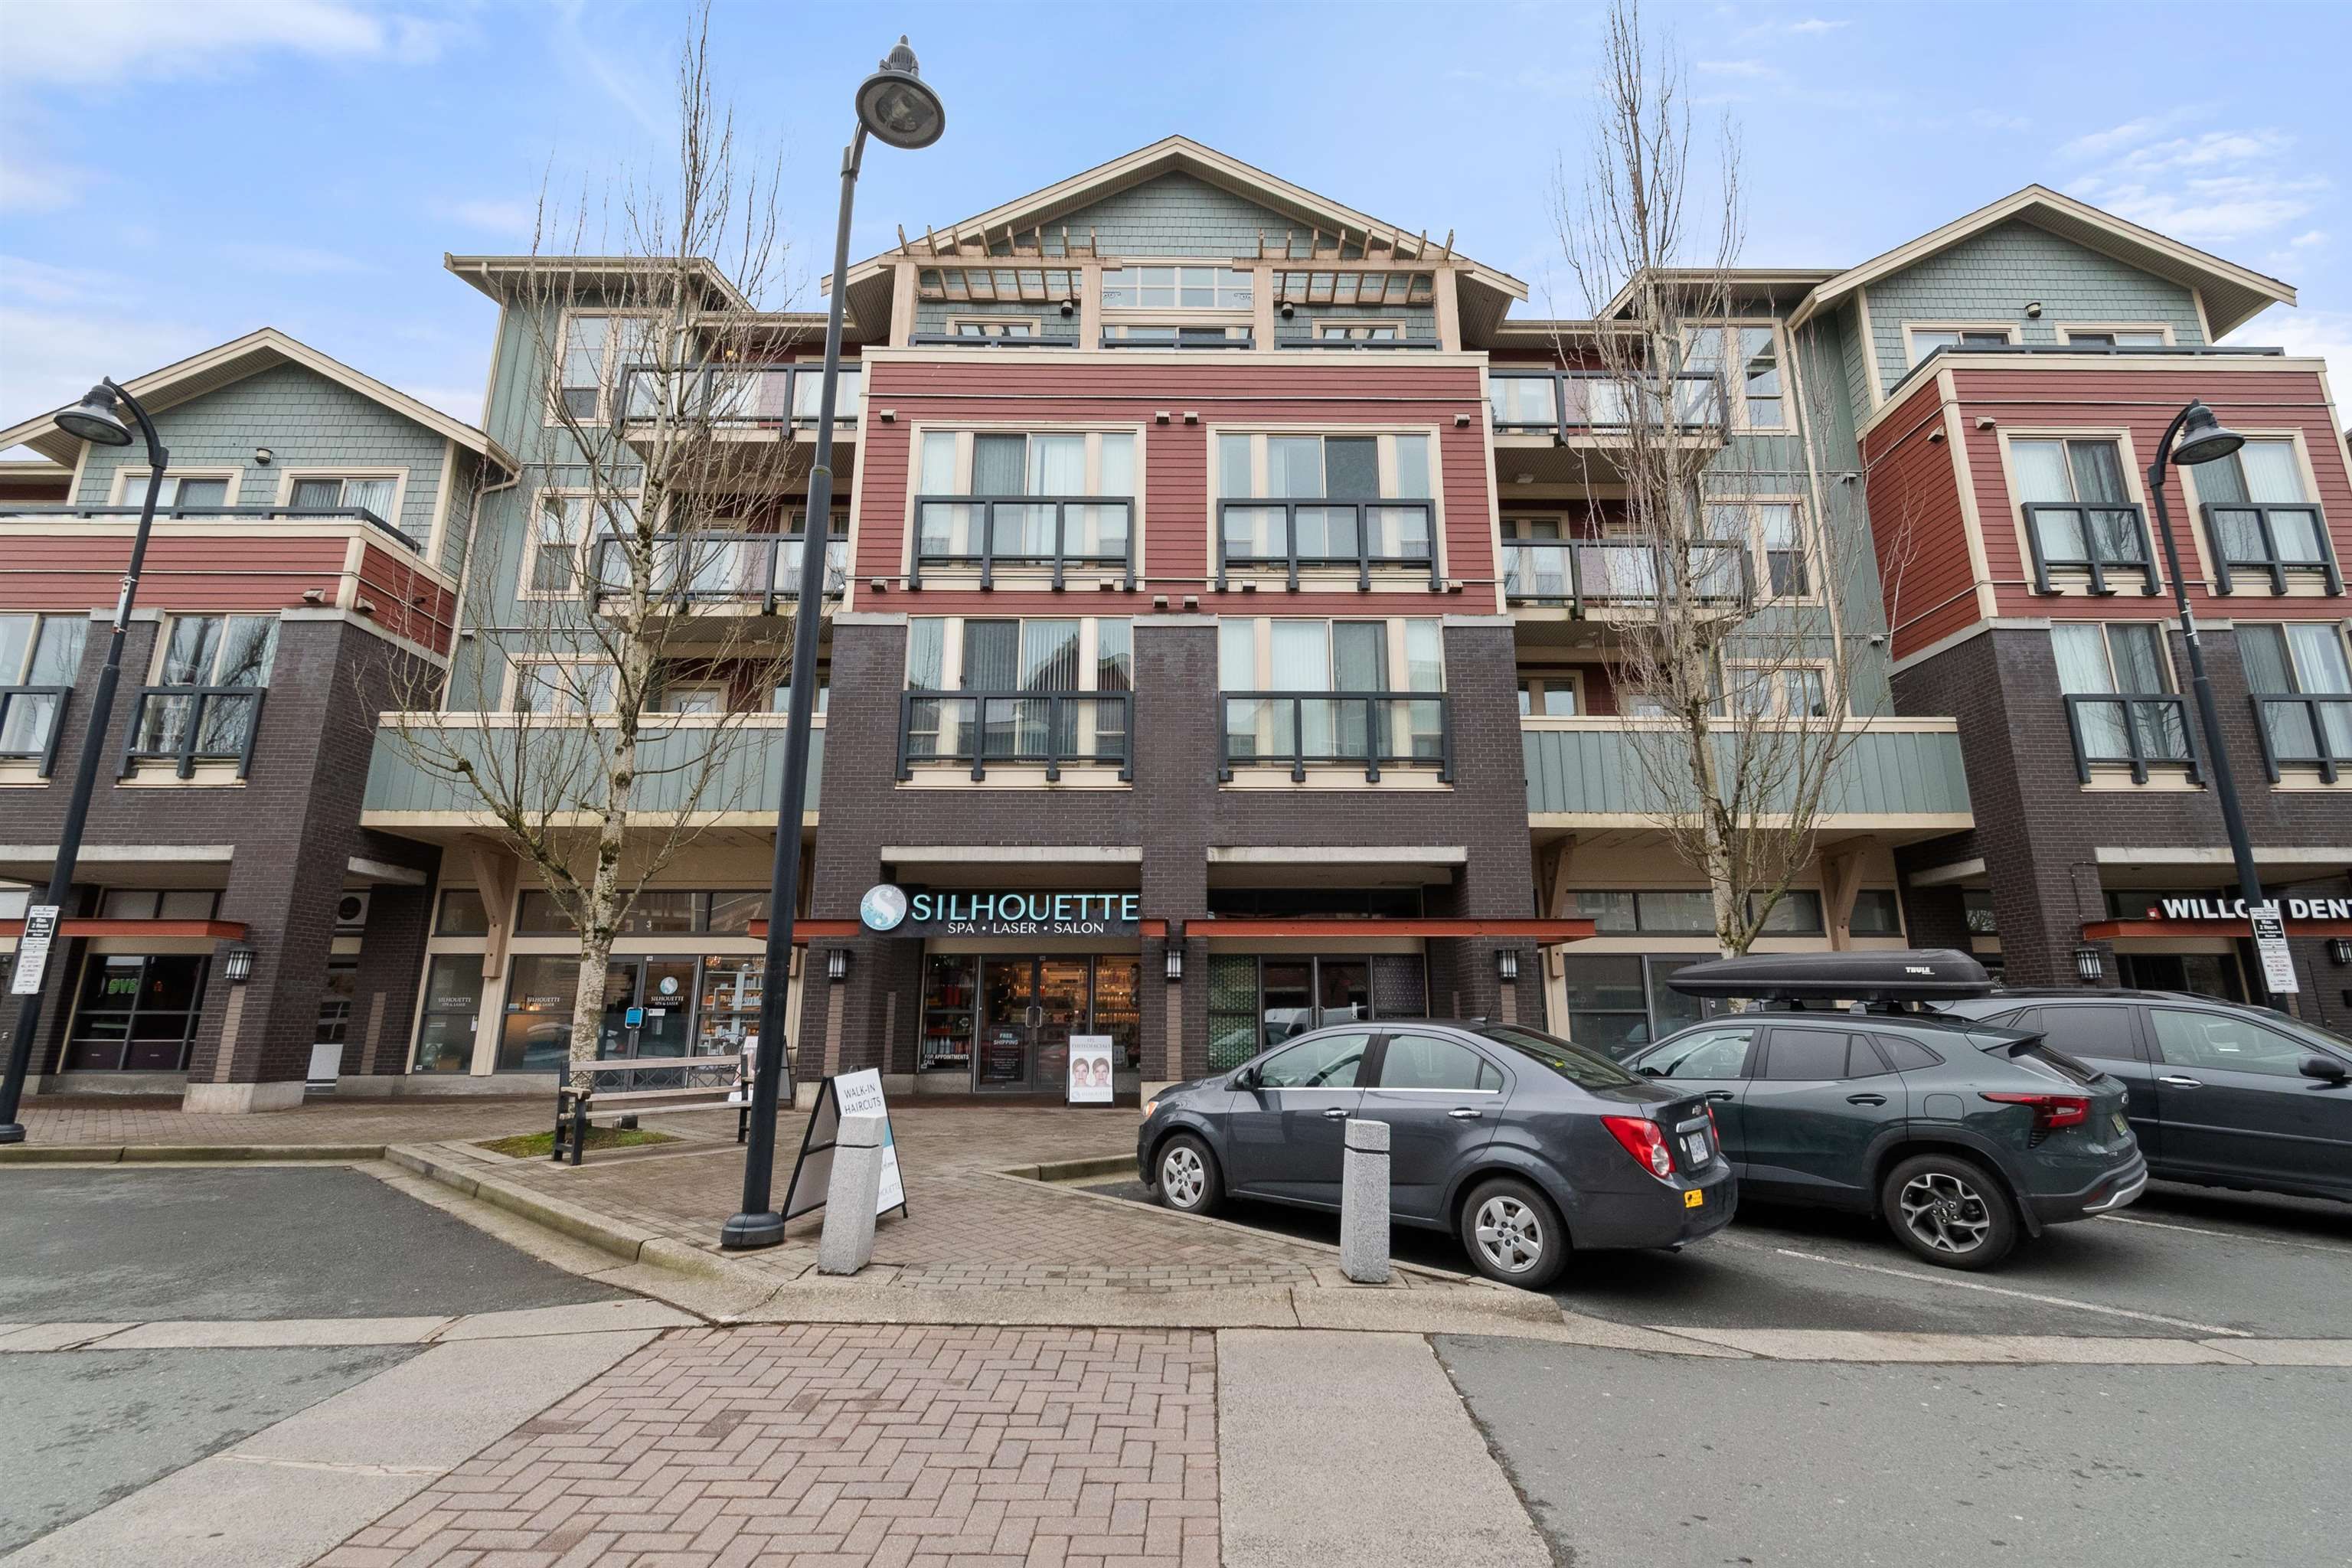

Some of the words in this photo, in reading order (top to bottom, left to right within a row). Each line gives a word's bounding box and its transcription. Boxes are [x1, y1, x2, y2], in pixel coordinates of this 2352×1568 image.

[911, 894, 1140, 920] SILHOUETTE
[948, 923, 975, 934] SPA
[993, 923, 1037, 934] LASER
[1054, 923, 1104, 934] SALON
[844, 1083, 877, 1099] WALK-IN
[844, 1096, 881, 1115] HAIRCUTS
